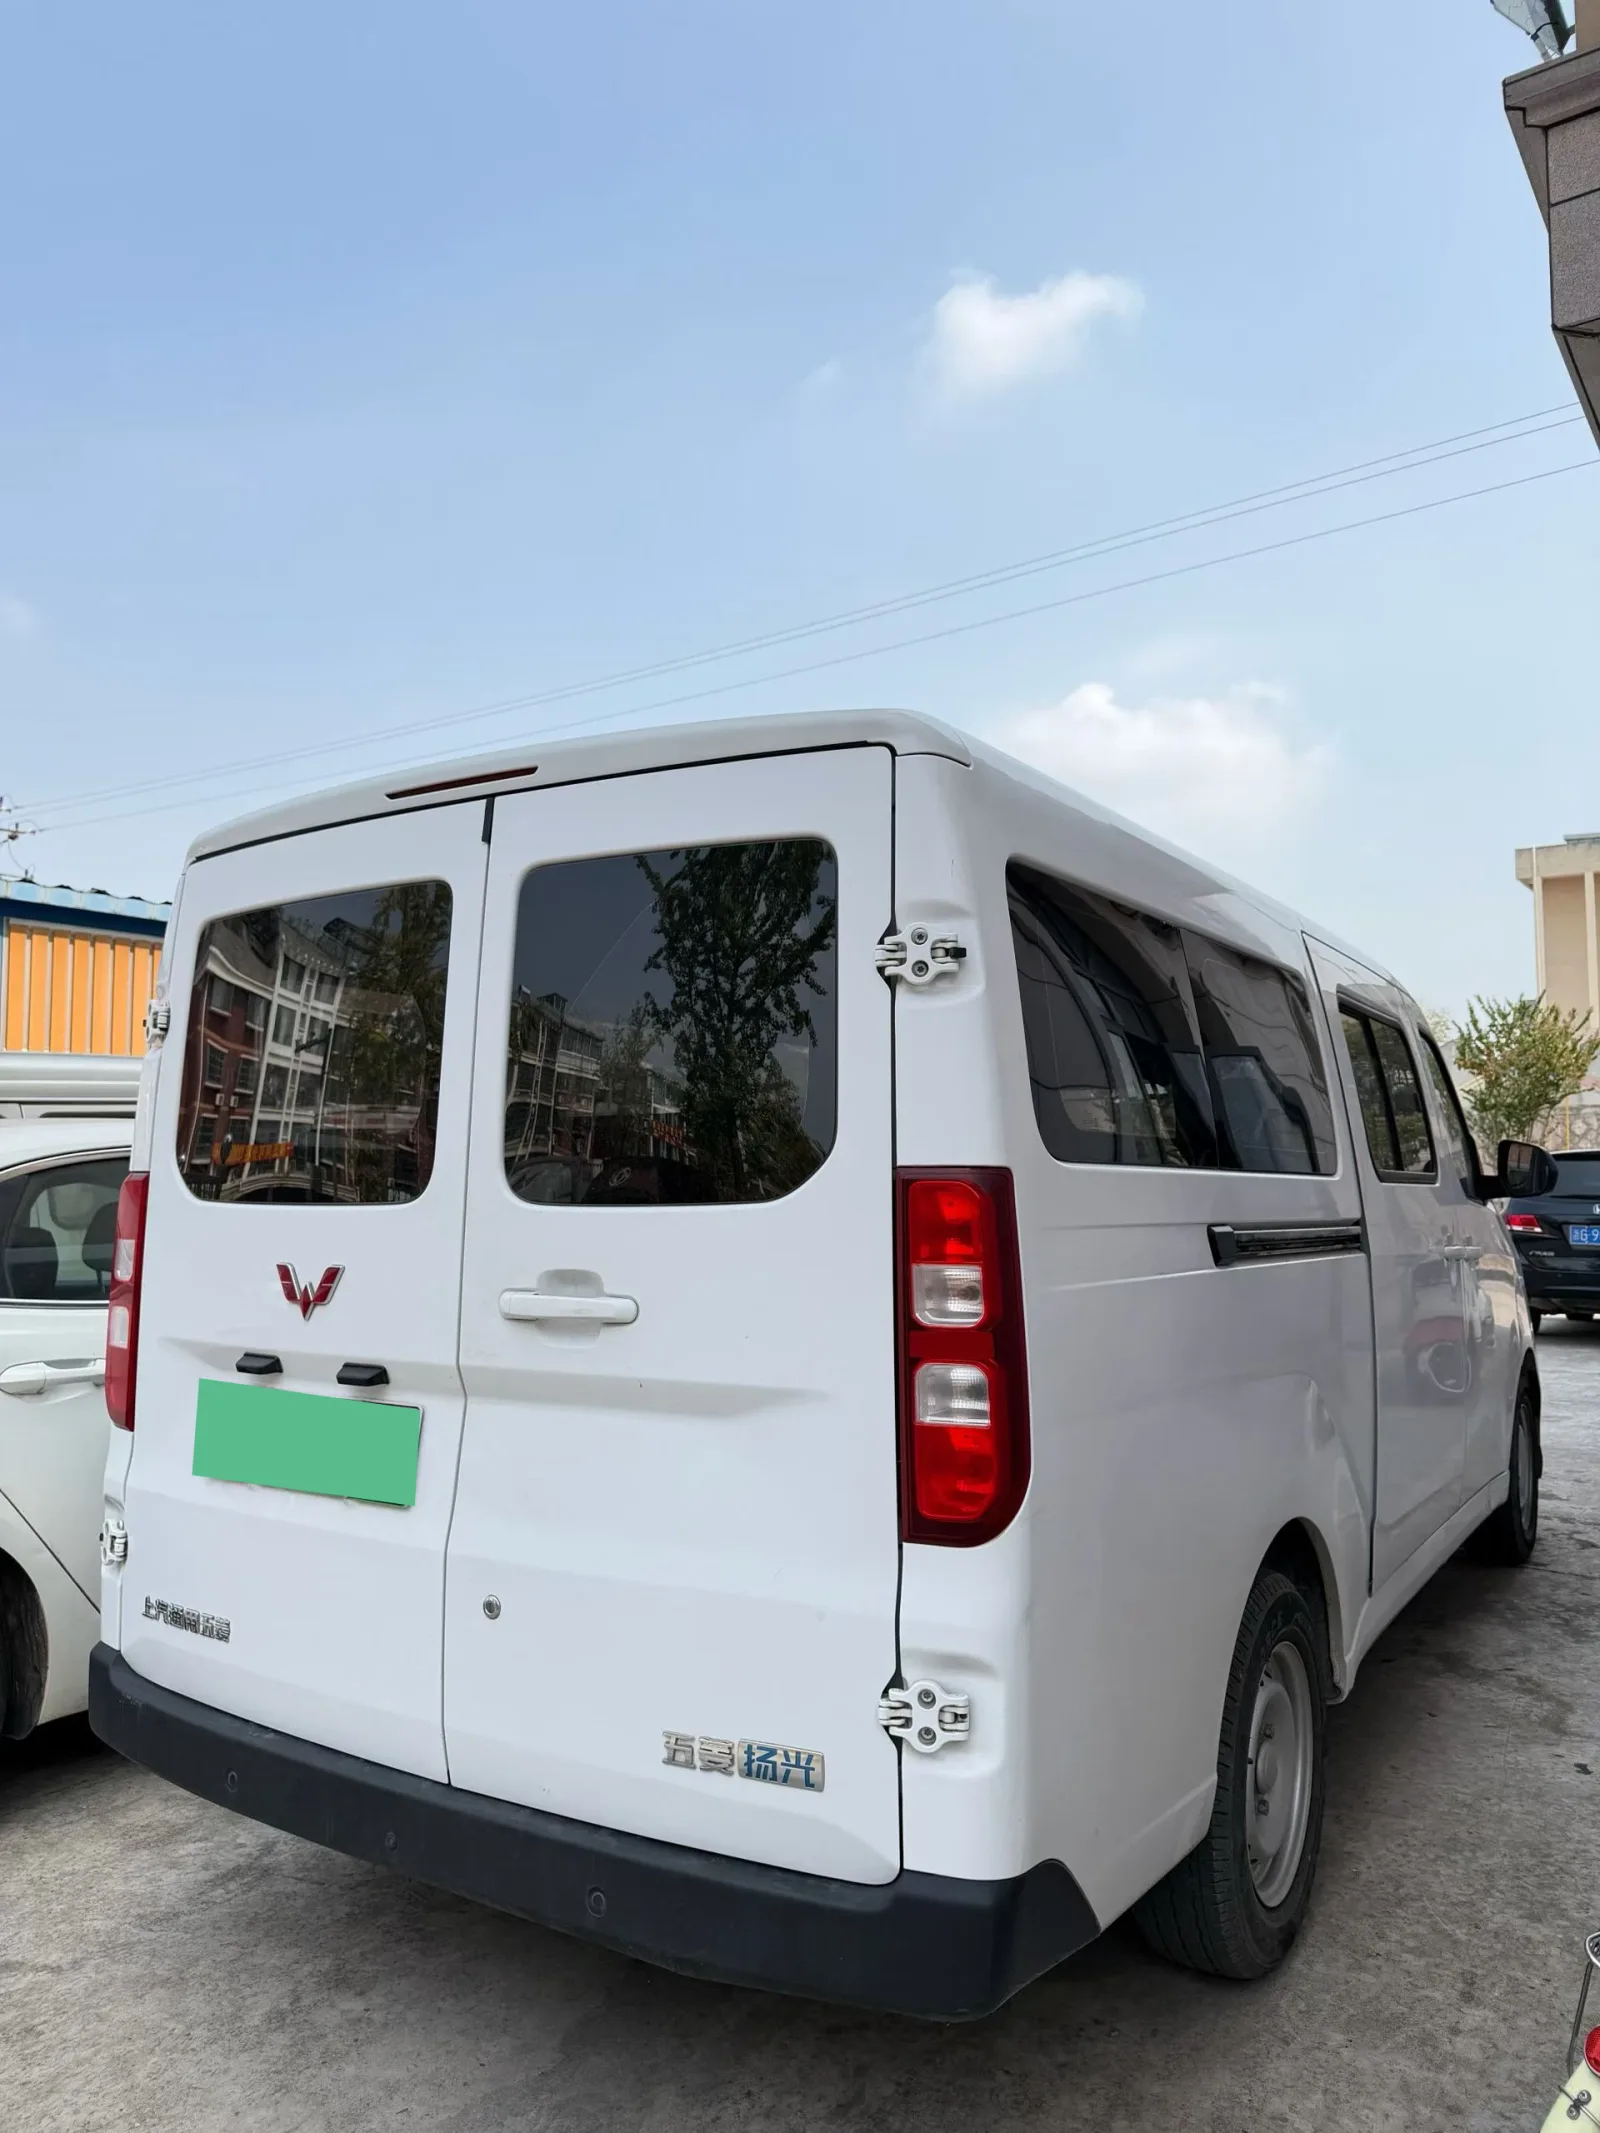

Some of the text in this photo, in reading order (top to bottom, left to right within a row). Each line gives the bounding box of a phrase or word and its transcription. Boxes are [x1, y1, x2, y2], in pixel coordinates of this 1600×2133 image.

[142, 1594, 231, 1643] 上汽通用五菱
[661, 1730, 817, 1790] 五菱扬光
